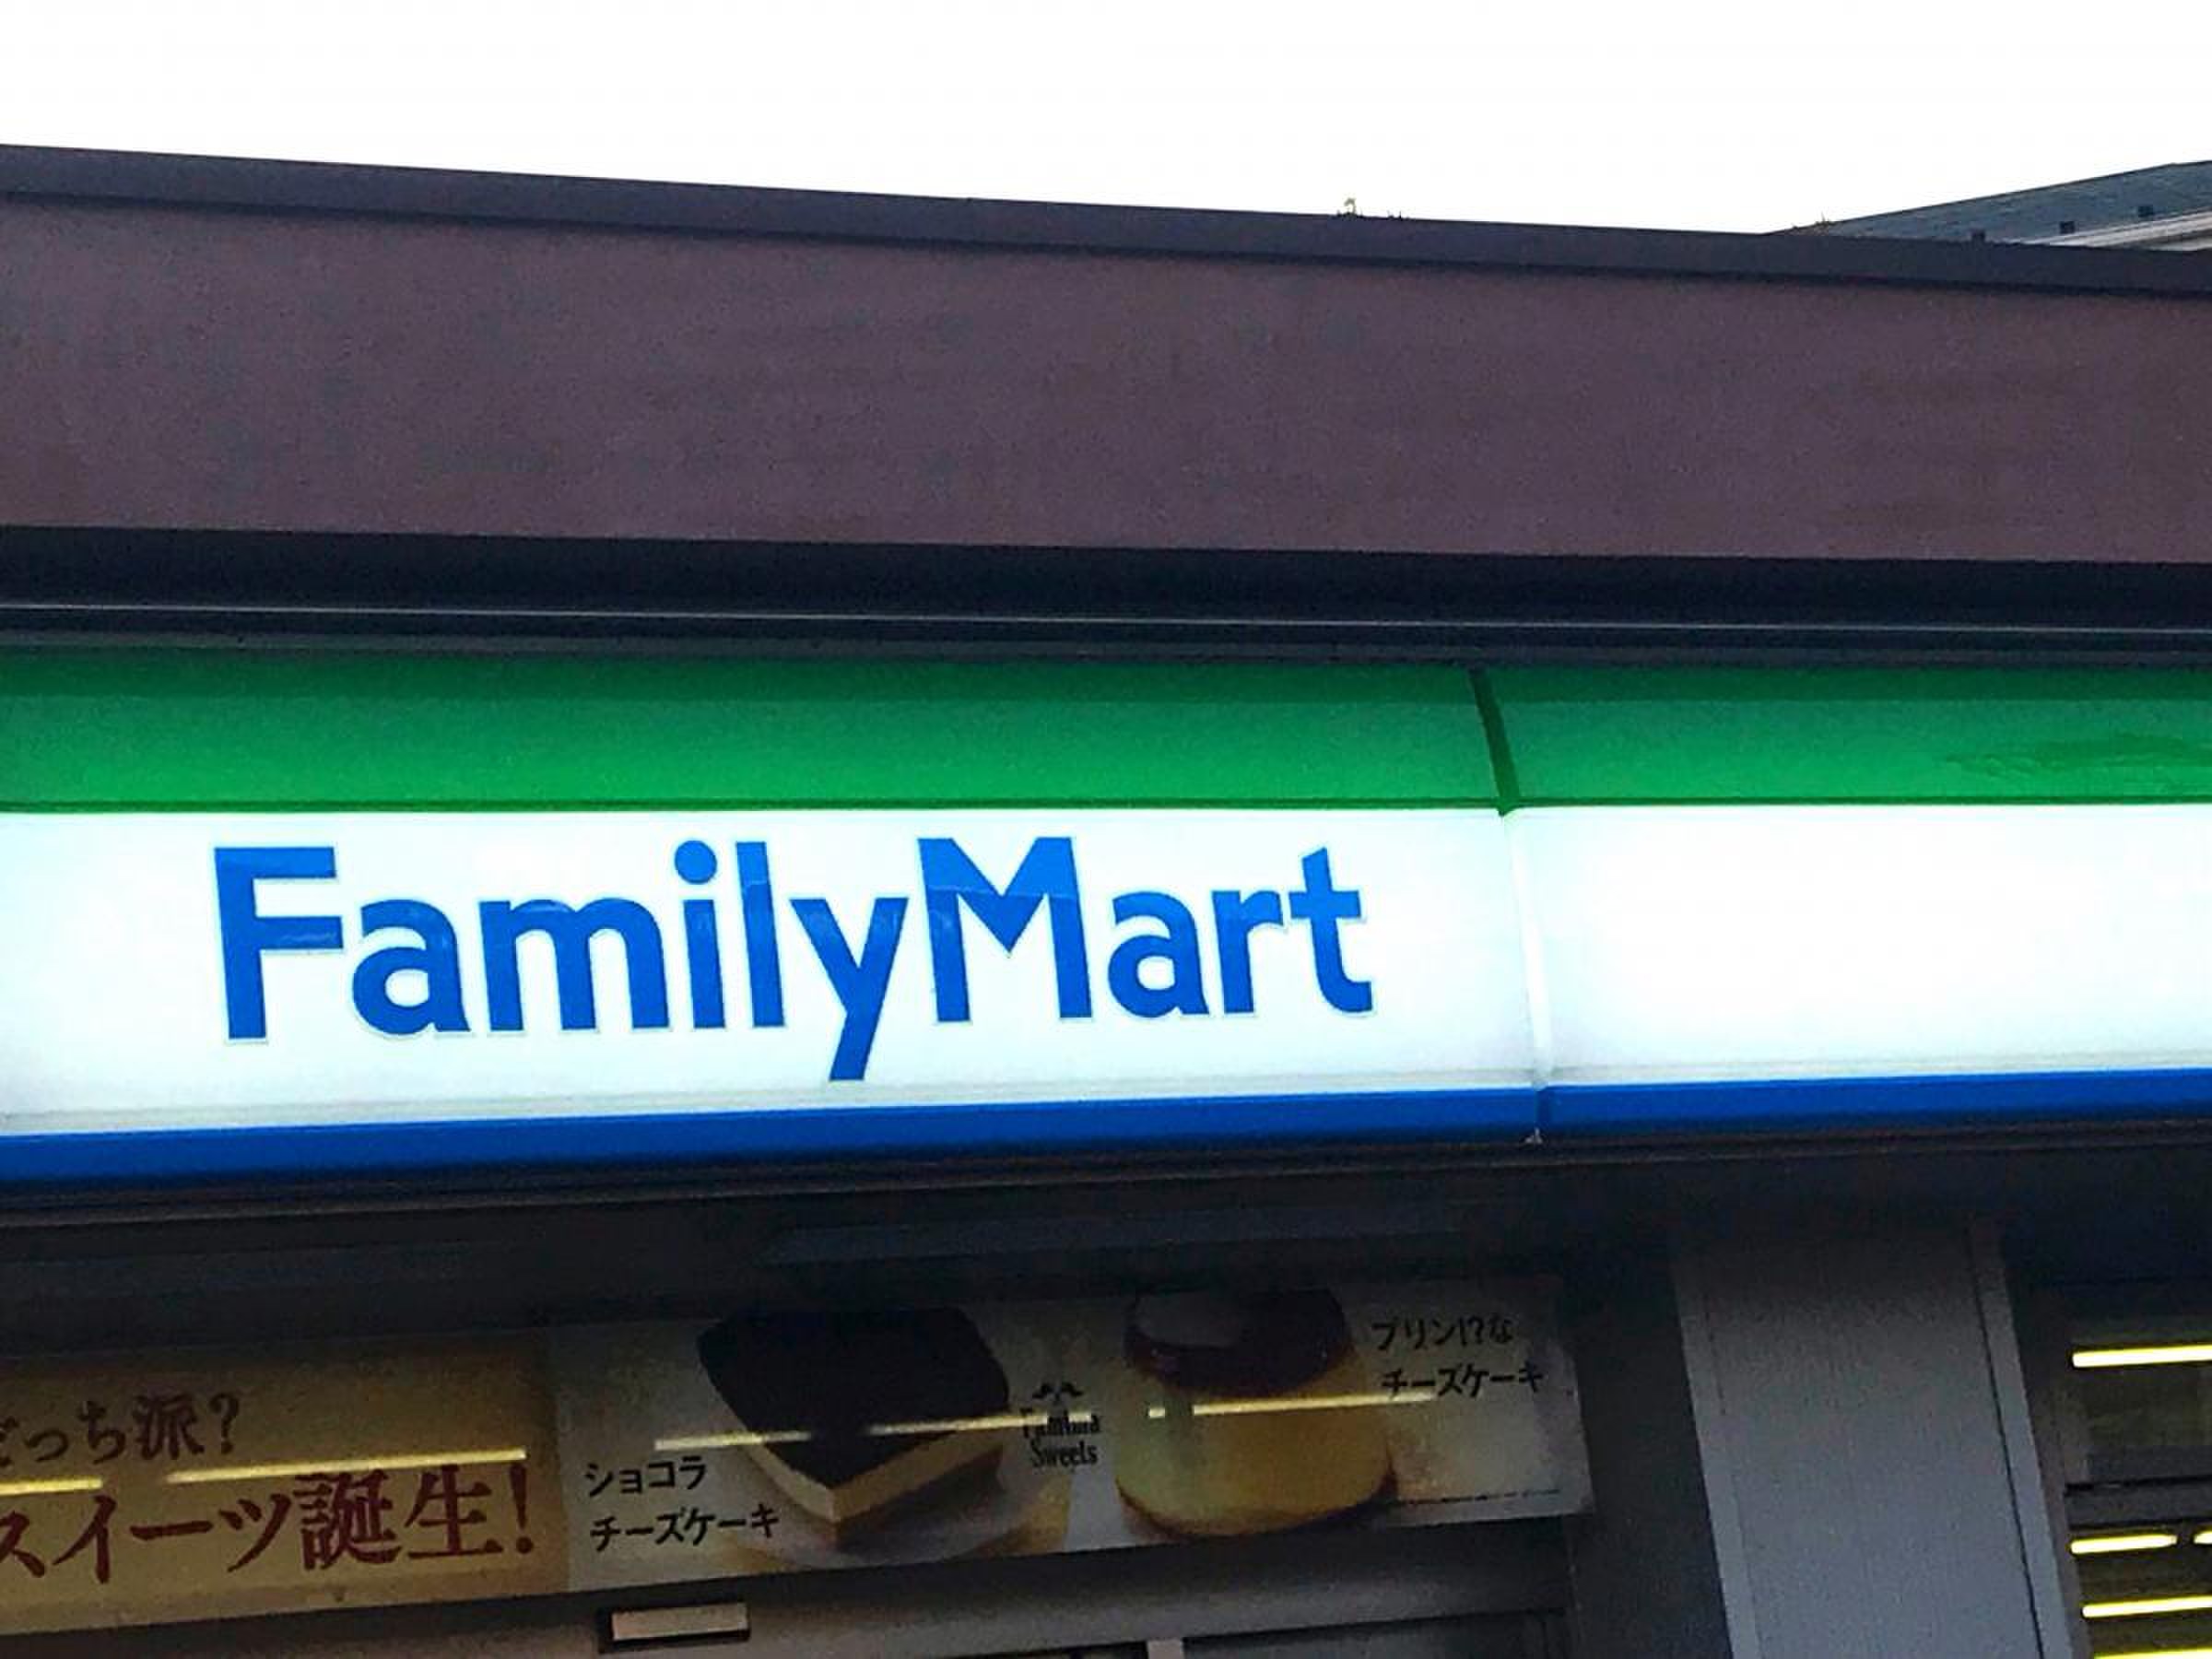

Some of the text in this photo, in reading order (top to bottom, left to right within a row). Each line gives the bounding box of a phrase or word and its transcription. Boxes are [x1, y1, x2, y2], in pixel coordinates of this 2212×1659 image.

[214, 835, 1371, 1081] FamilyMart
[1382, 1359, 1544, 1399] チーズケーキ
[584, 1455, 708, 1498] ショコラ
[590, 1502, 780, 1552] チーズケーキ
